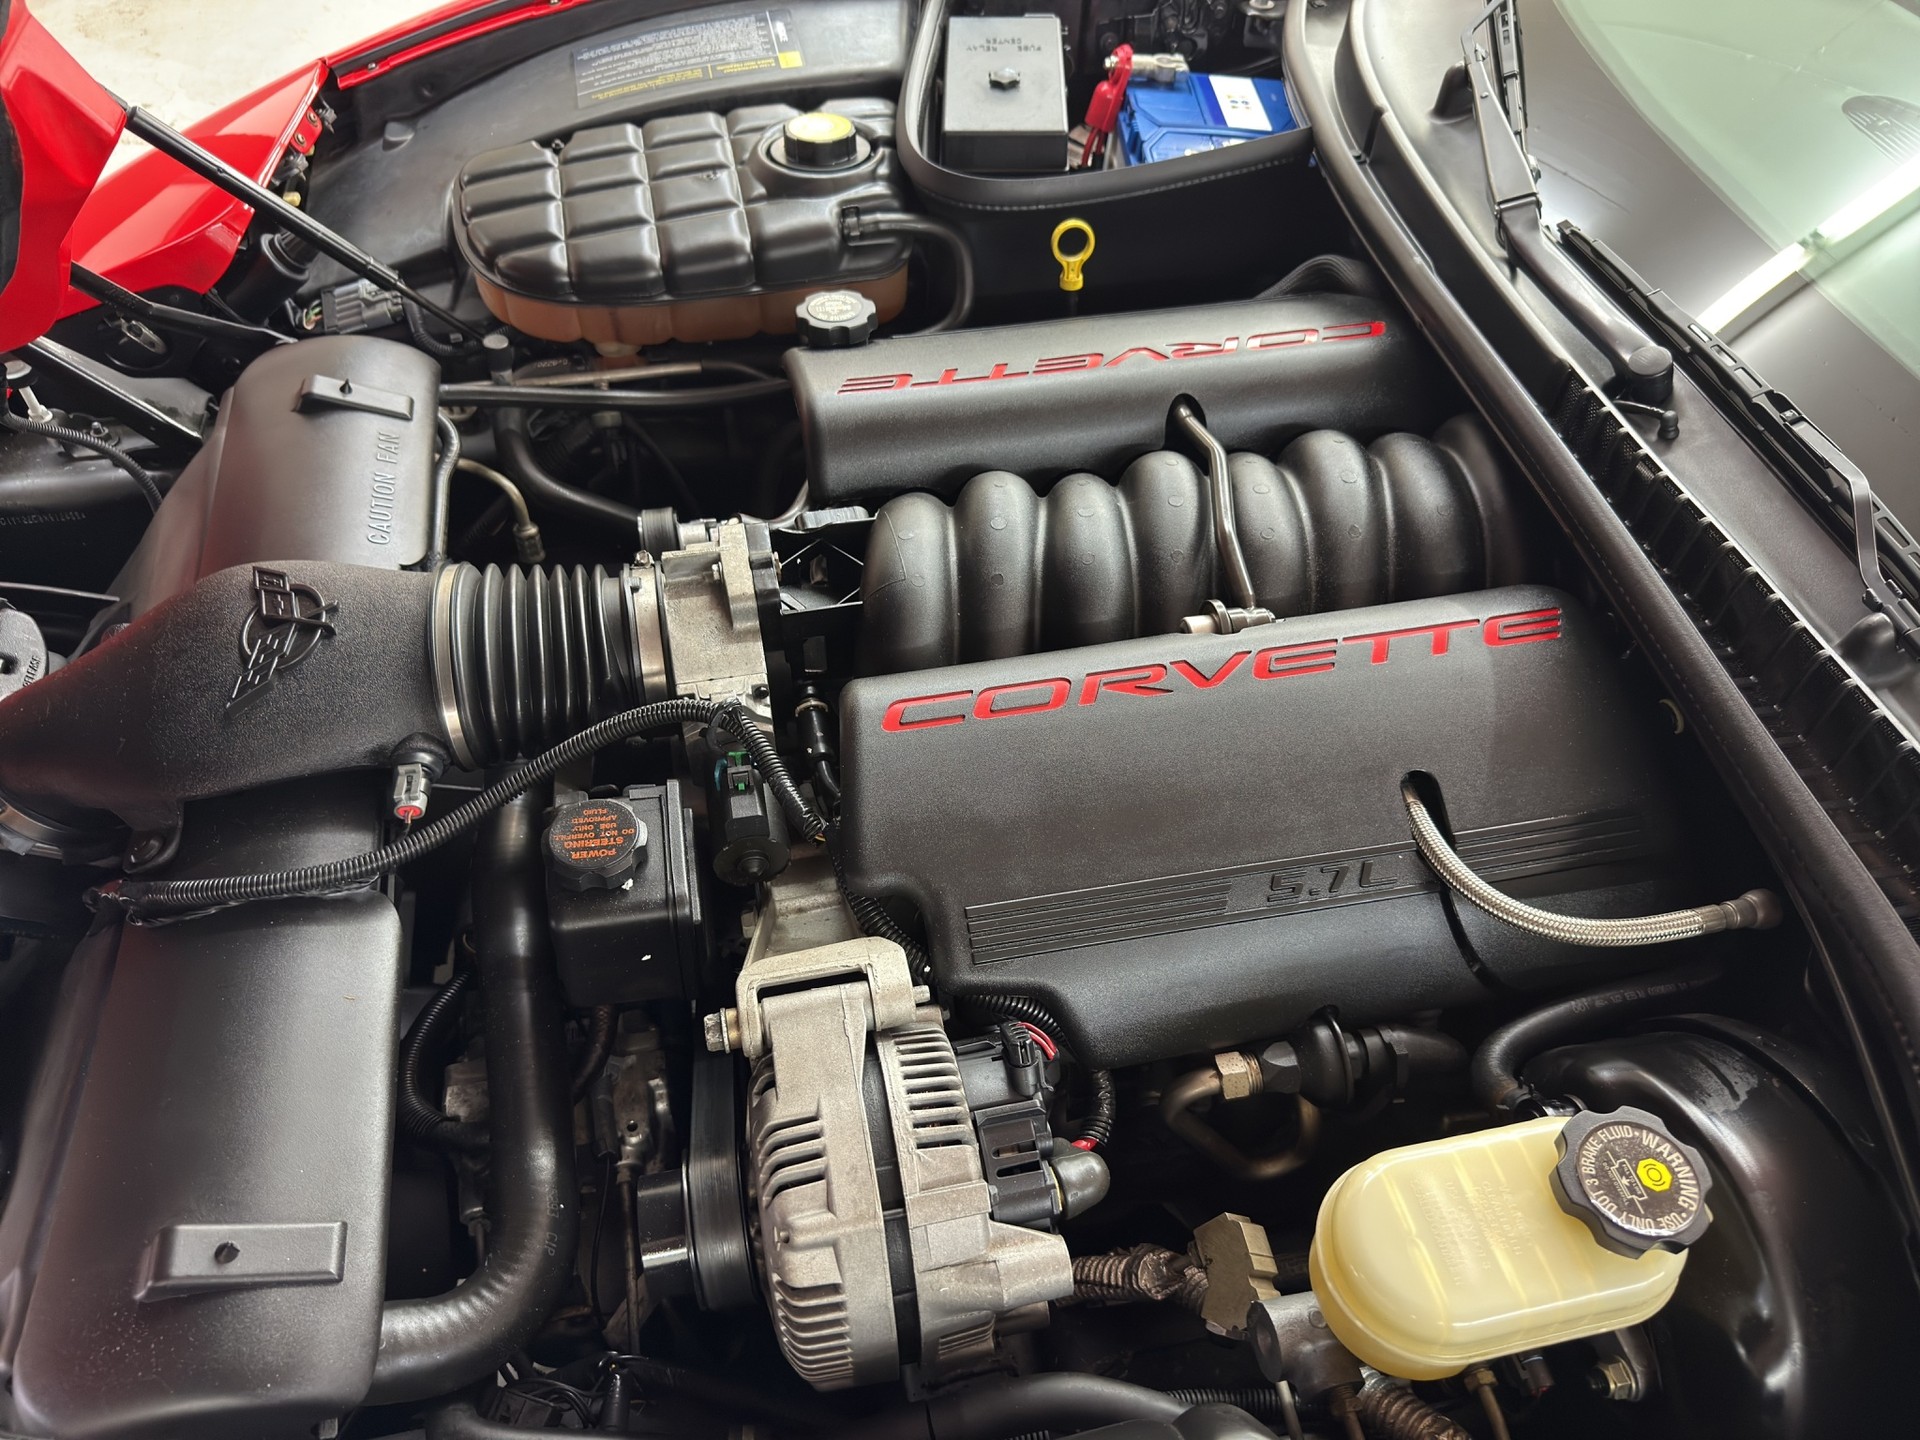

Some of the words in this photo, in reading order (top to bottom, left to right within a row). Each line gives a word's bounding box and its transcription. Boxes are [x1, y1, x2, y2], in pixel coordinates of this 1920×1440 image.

[837, 320, 1387, 395] CORVETTE
[376, 431, 400, 464] FAN
[367, 471, 396, 545] CAUTION
[881, 607, 1562, 732] CORVETTE
[572, 815, 617, 823] APPROVED
[554, 832, 595, 840] OVERFILL
[564, 837, 624, 848] STEERING
[572, 849, 617, 859] POWER
[1267, 859, 1399, 903] 5.7L
[1597, 1125, 1633, 1142] FLUID
[1581, 1137, 1603, 1174] BRAKE
[1642, 1130, 1699, 1211] WARNING
[1585, 1178, 1599, 1186] 3
[1589, 1190, 1618, 1214] DOT
[1619, 1211, 1654, 1230] ONLY
[1656, 1212, 1684, 1230] USE
